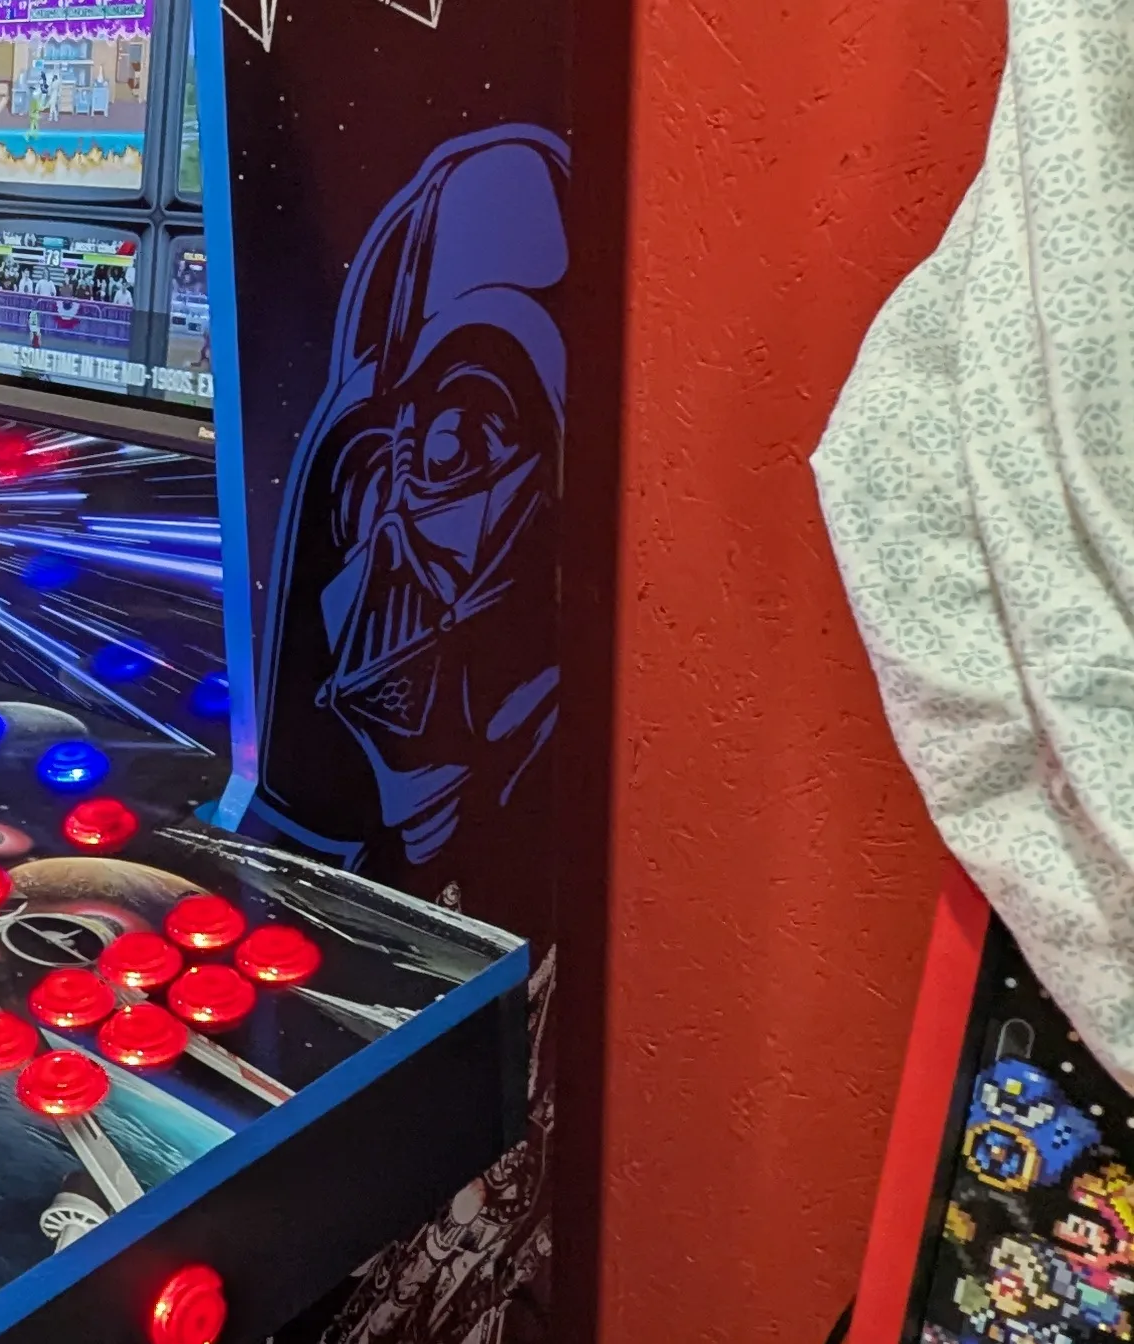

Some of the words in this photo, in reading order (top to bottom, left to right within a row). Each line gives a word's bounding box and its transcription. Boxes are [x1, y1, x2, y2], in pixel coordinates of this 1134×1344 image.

[45, 249, 61, 267] 73
[19, 345, 78, 376] SOMETIME
[80, 354, 93, 377] IN
[95, 357, 120, 382] THE
[121, 360, 194, 395] MID-1980S.
